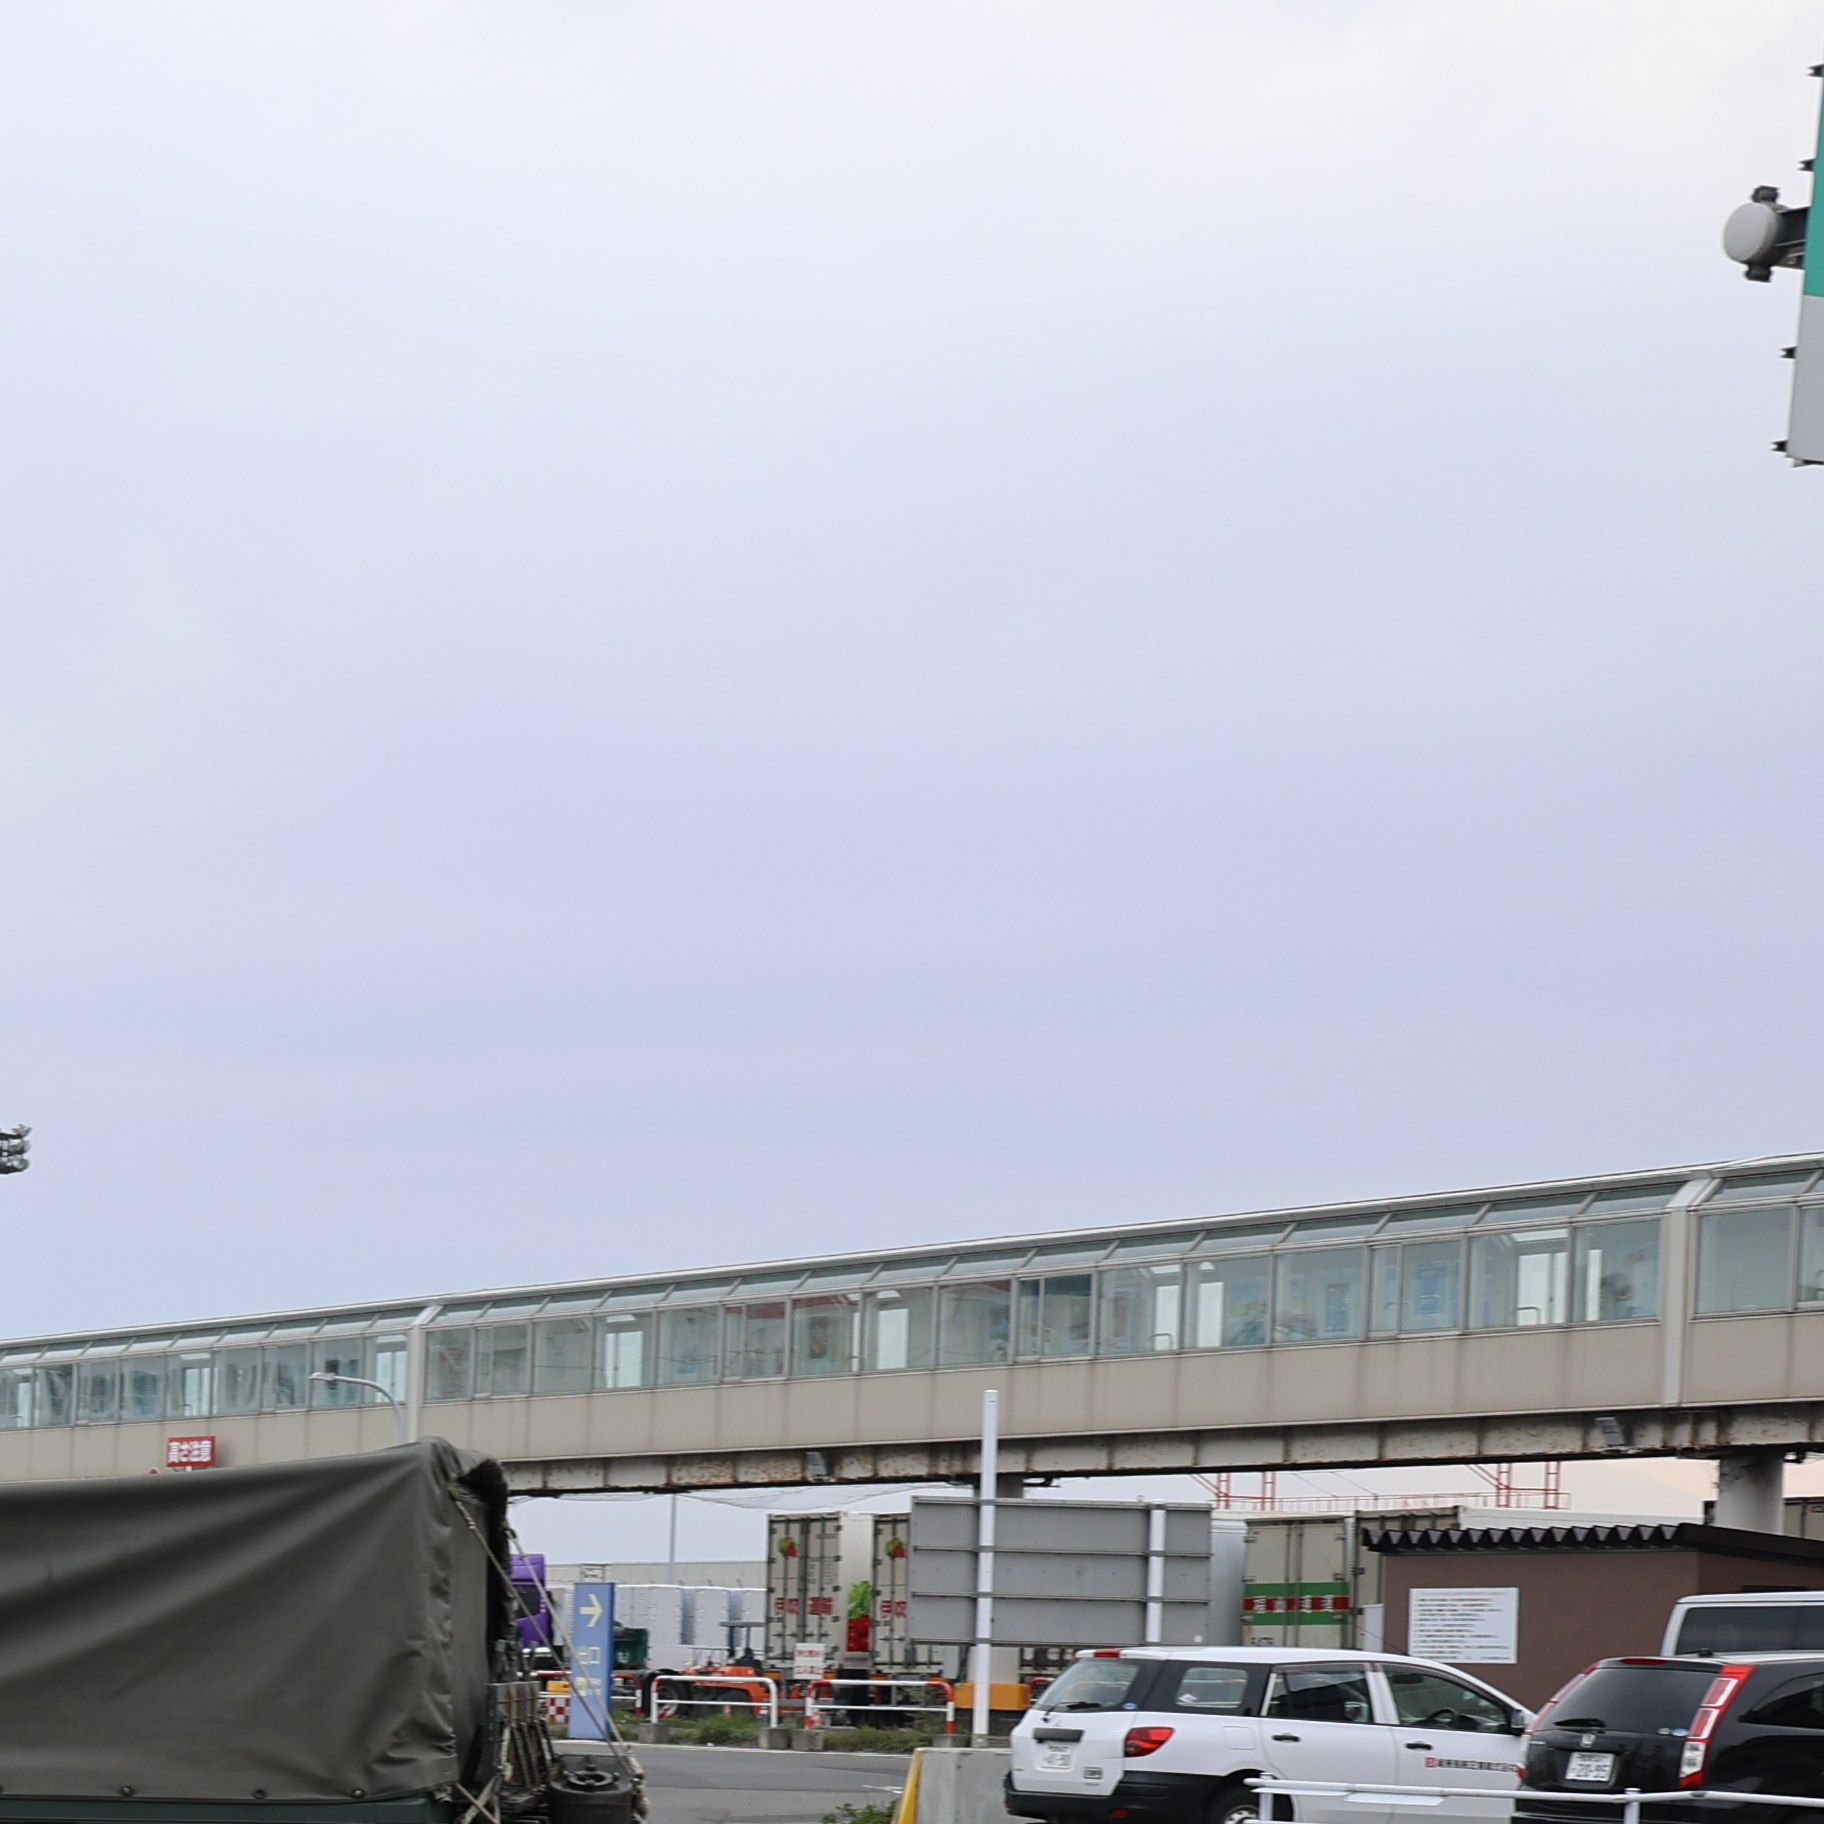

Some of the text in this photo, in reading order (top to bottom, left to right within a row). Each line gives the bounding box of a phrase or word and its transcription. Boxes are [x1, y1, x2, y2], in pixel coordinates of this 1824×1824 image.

[168, 1440, 212, 1464] 高さ注意
[575, 1645, 602, 1665] 出口
